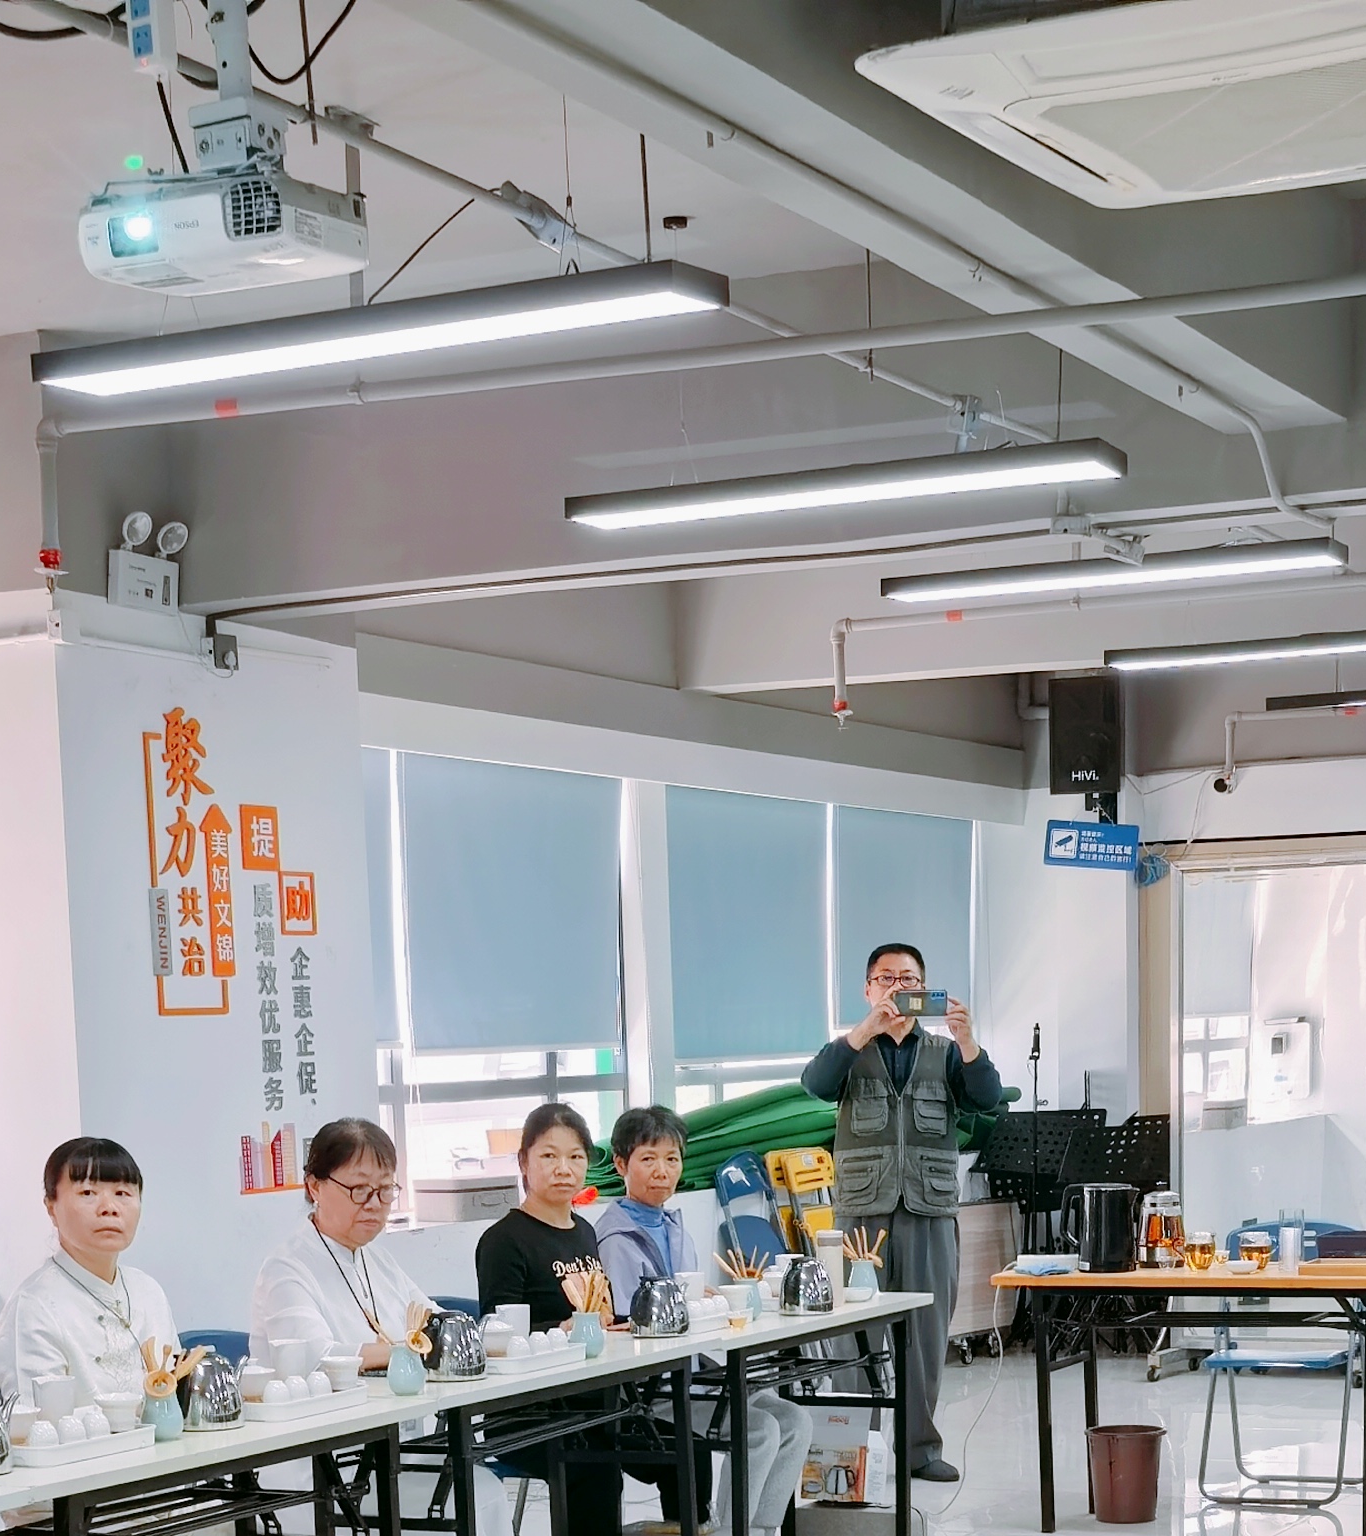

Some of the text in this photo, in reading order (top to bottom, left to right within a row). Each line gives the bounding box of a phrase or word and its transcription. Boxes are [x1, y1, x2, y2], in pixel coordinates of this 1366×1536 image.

[159, 707, 215, 976] 聚力共治
[155, 894, 169, 970] WENJIN
[211, 829, 234, 962] 美好文锦
[552, 1256, 586, 1278] Don't
